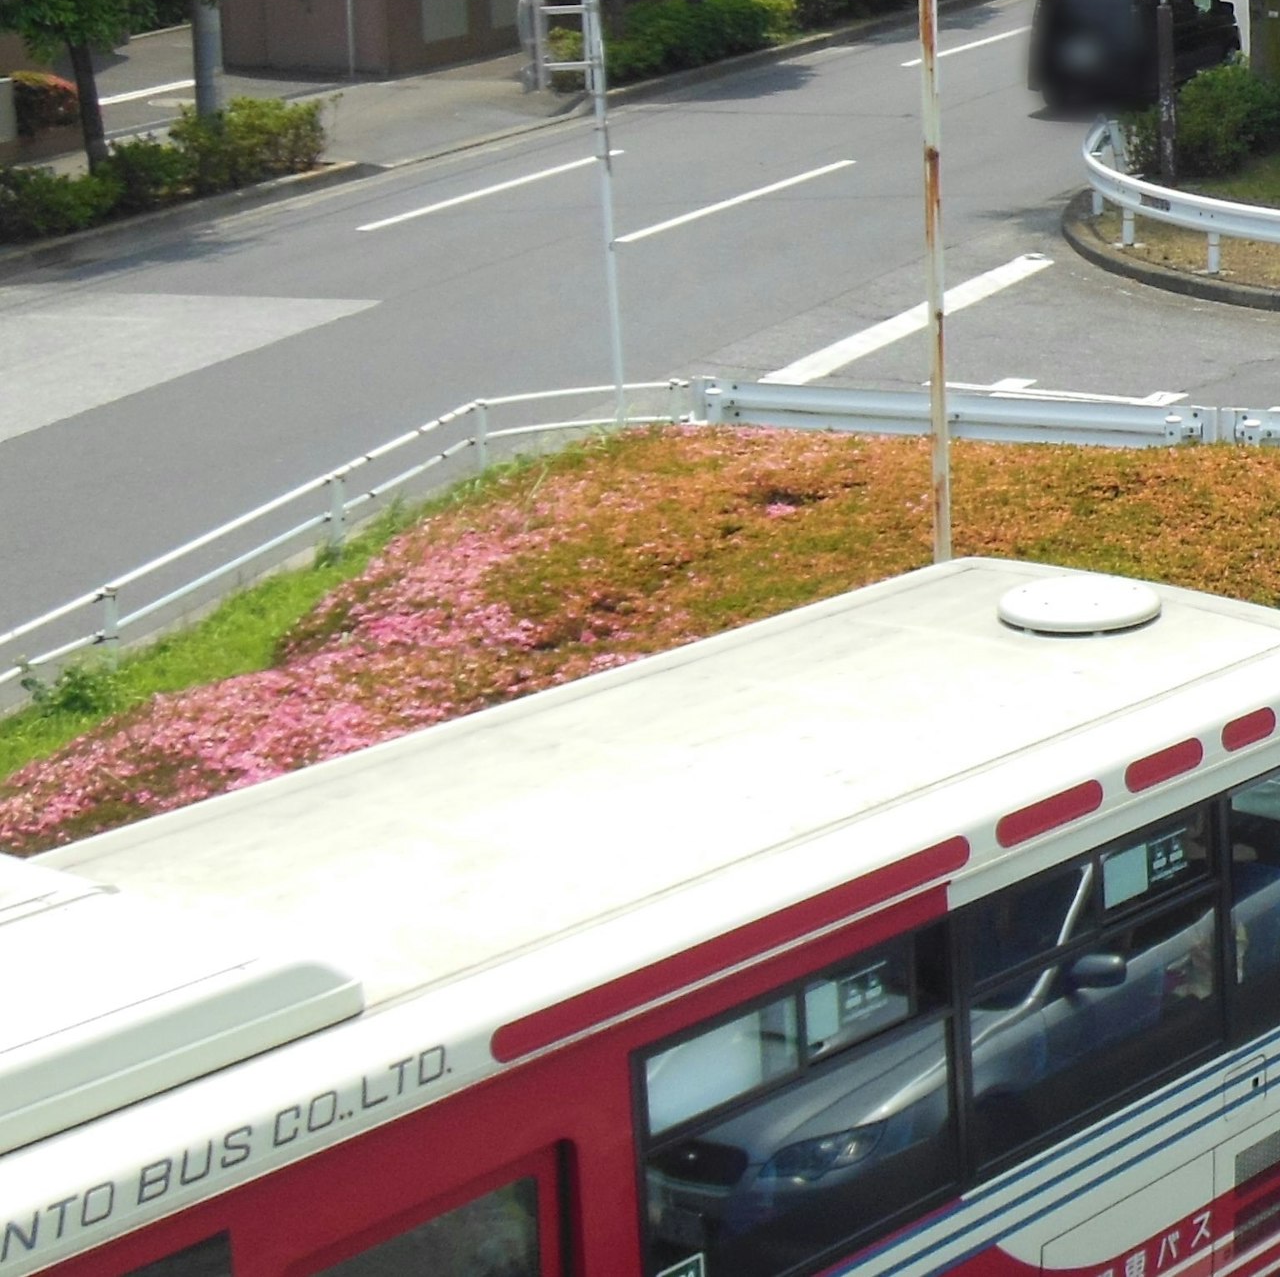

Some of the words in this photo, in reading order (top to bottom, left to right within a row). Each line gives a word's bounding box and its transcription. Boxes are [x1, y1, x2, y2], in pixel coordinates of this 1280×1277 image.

[137, 1125, 252, 1205] BUS
[1097, 1210, 1212, 1277] 東バス
